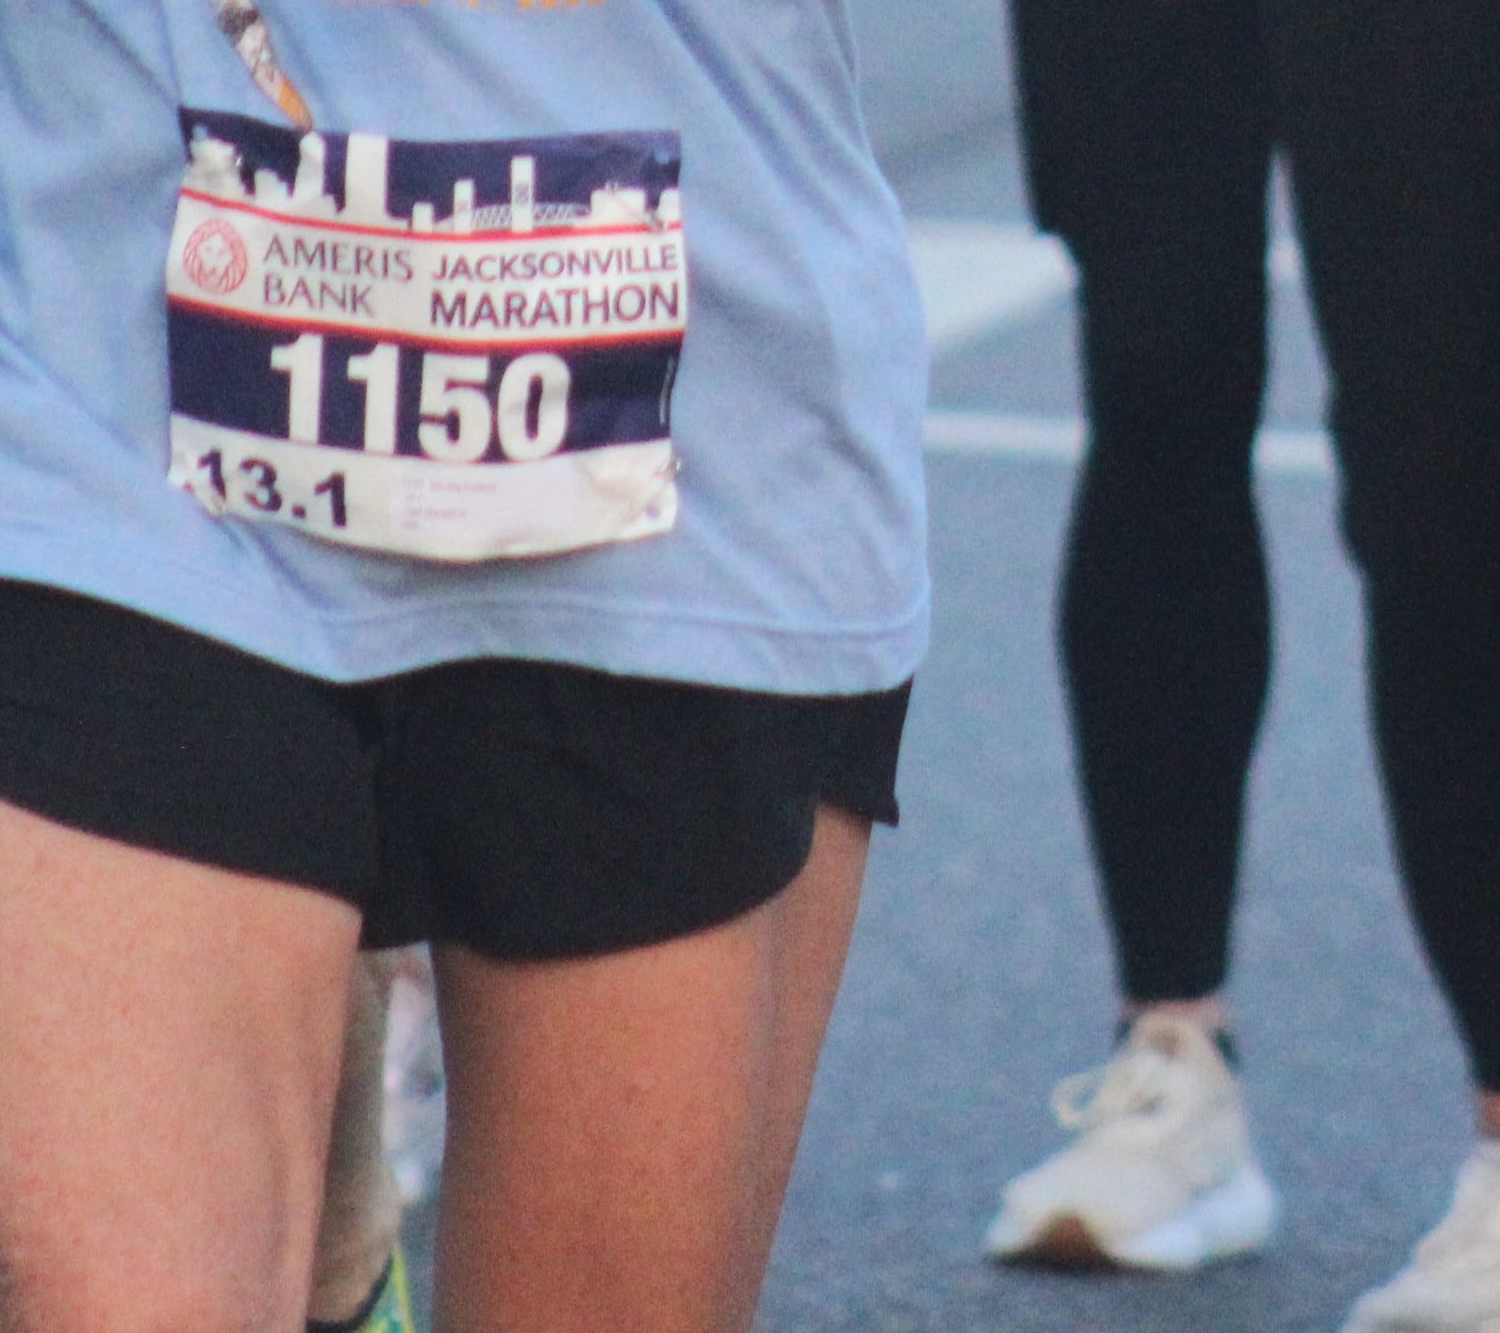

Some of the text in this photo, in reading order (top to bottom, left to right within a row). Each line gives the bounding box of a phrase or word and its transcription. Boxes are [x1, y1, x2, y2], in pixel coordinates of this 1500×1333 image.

[263, 232, 413, 282] AMERIS
[431, 243, 679, 282] JACKSONVILLE
[262, 271, 376, 317] BANK
[430, 281, 680, 328] MARATHON
[270, 332, 571, 464] 1150
[197, 447, 348, 528] 13.1
